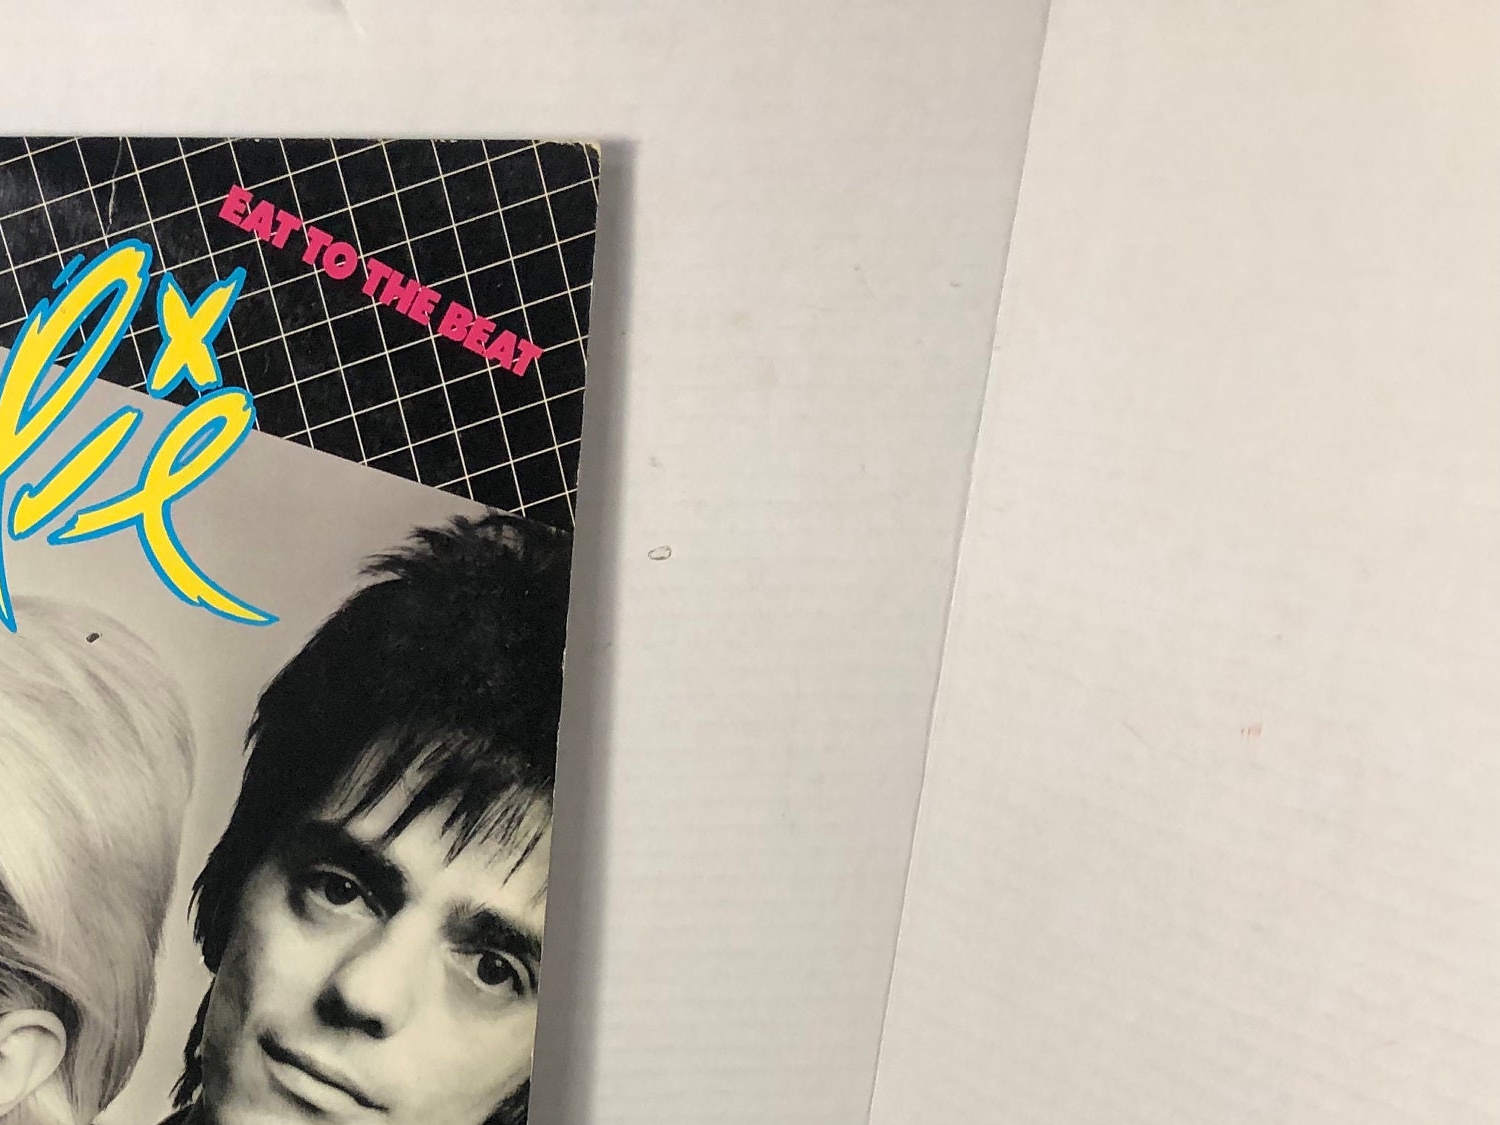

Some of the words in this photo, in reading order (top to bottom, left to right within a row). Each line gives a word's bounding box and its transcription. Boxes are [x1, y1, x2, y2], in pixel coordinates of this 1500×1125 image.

[218, 184, 303, 249] EAT
[301, 226, 358, 280] TO
[362, 257, 442, 326] THE
[437, 300, 544, 377] BEAT
